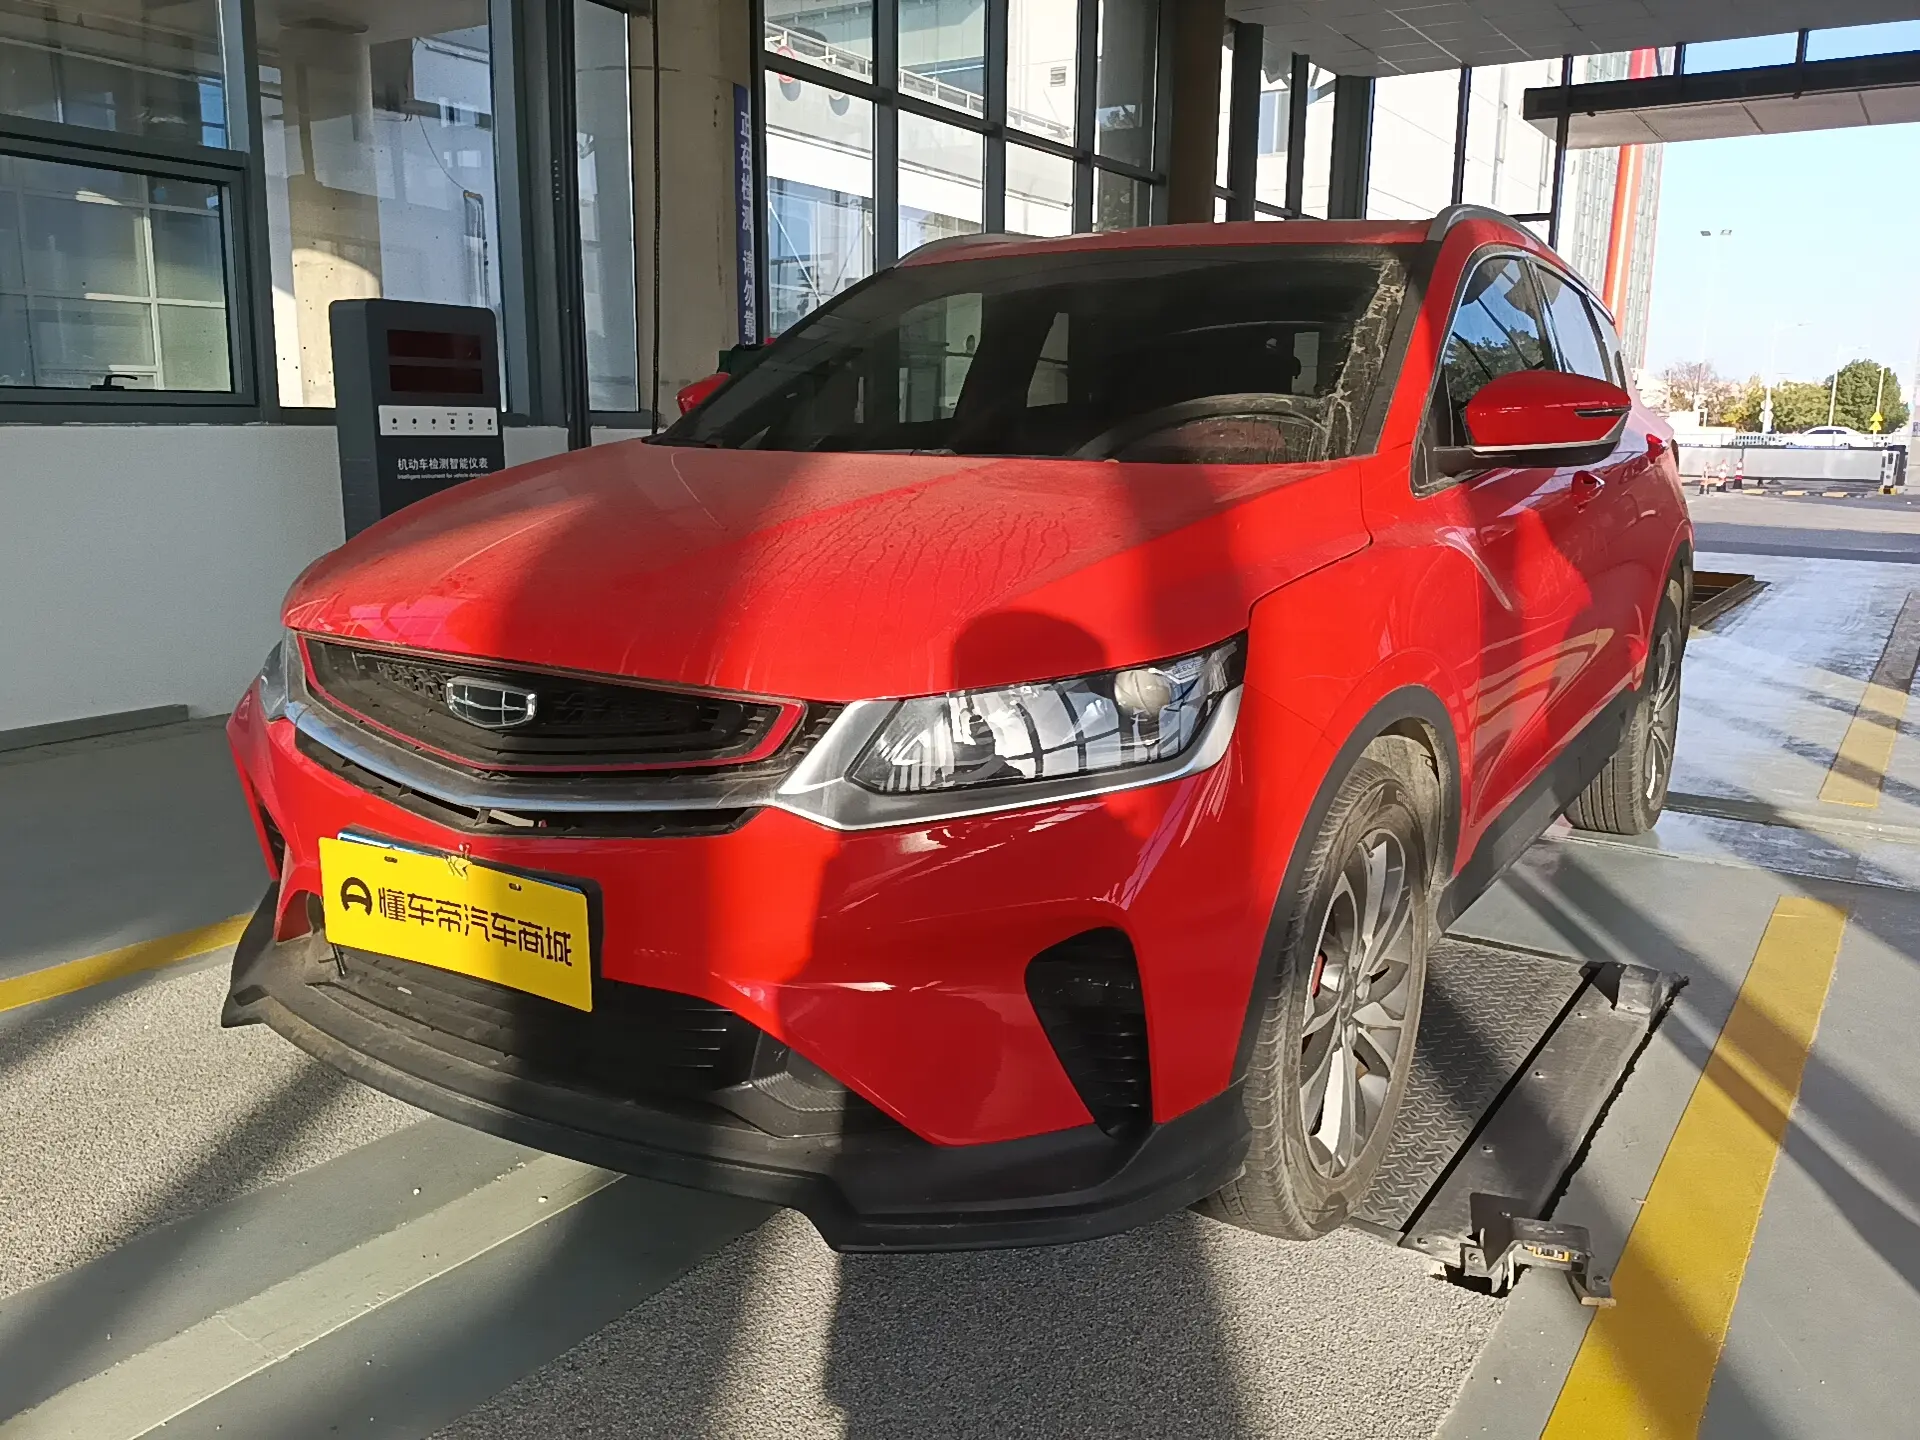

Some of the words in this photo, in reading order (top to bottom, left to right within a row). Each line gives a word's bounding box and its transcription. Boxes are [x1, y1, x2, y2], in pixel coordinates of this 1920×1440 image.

[397, 457, 488, 470] 机动车检测智能仪表
[378, 887, 573, 967] 懂车帝汽车商城
